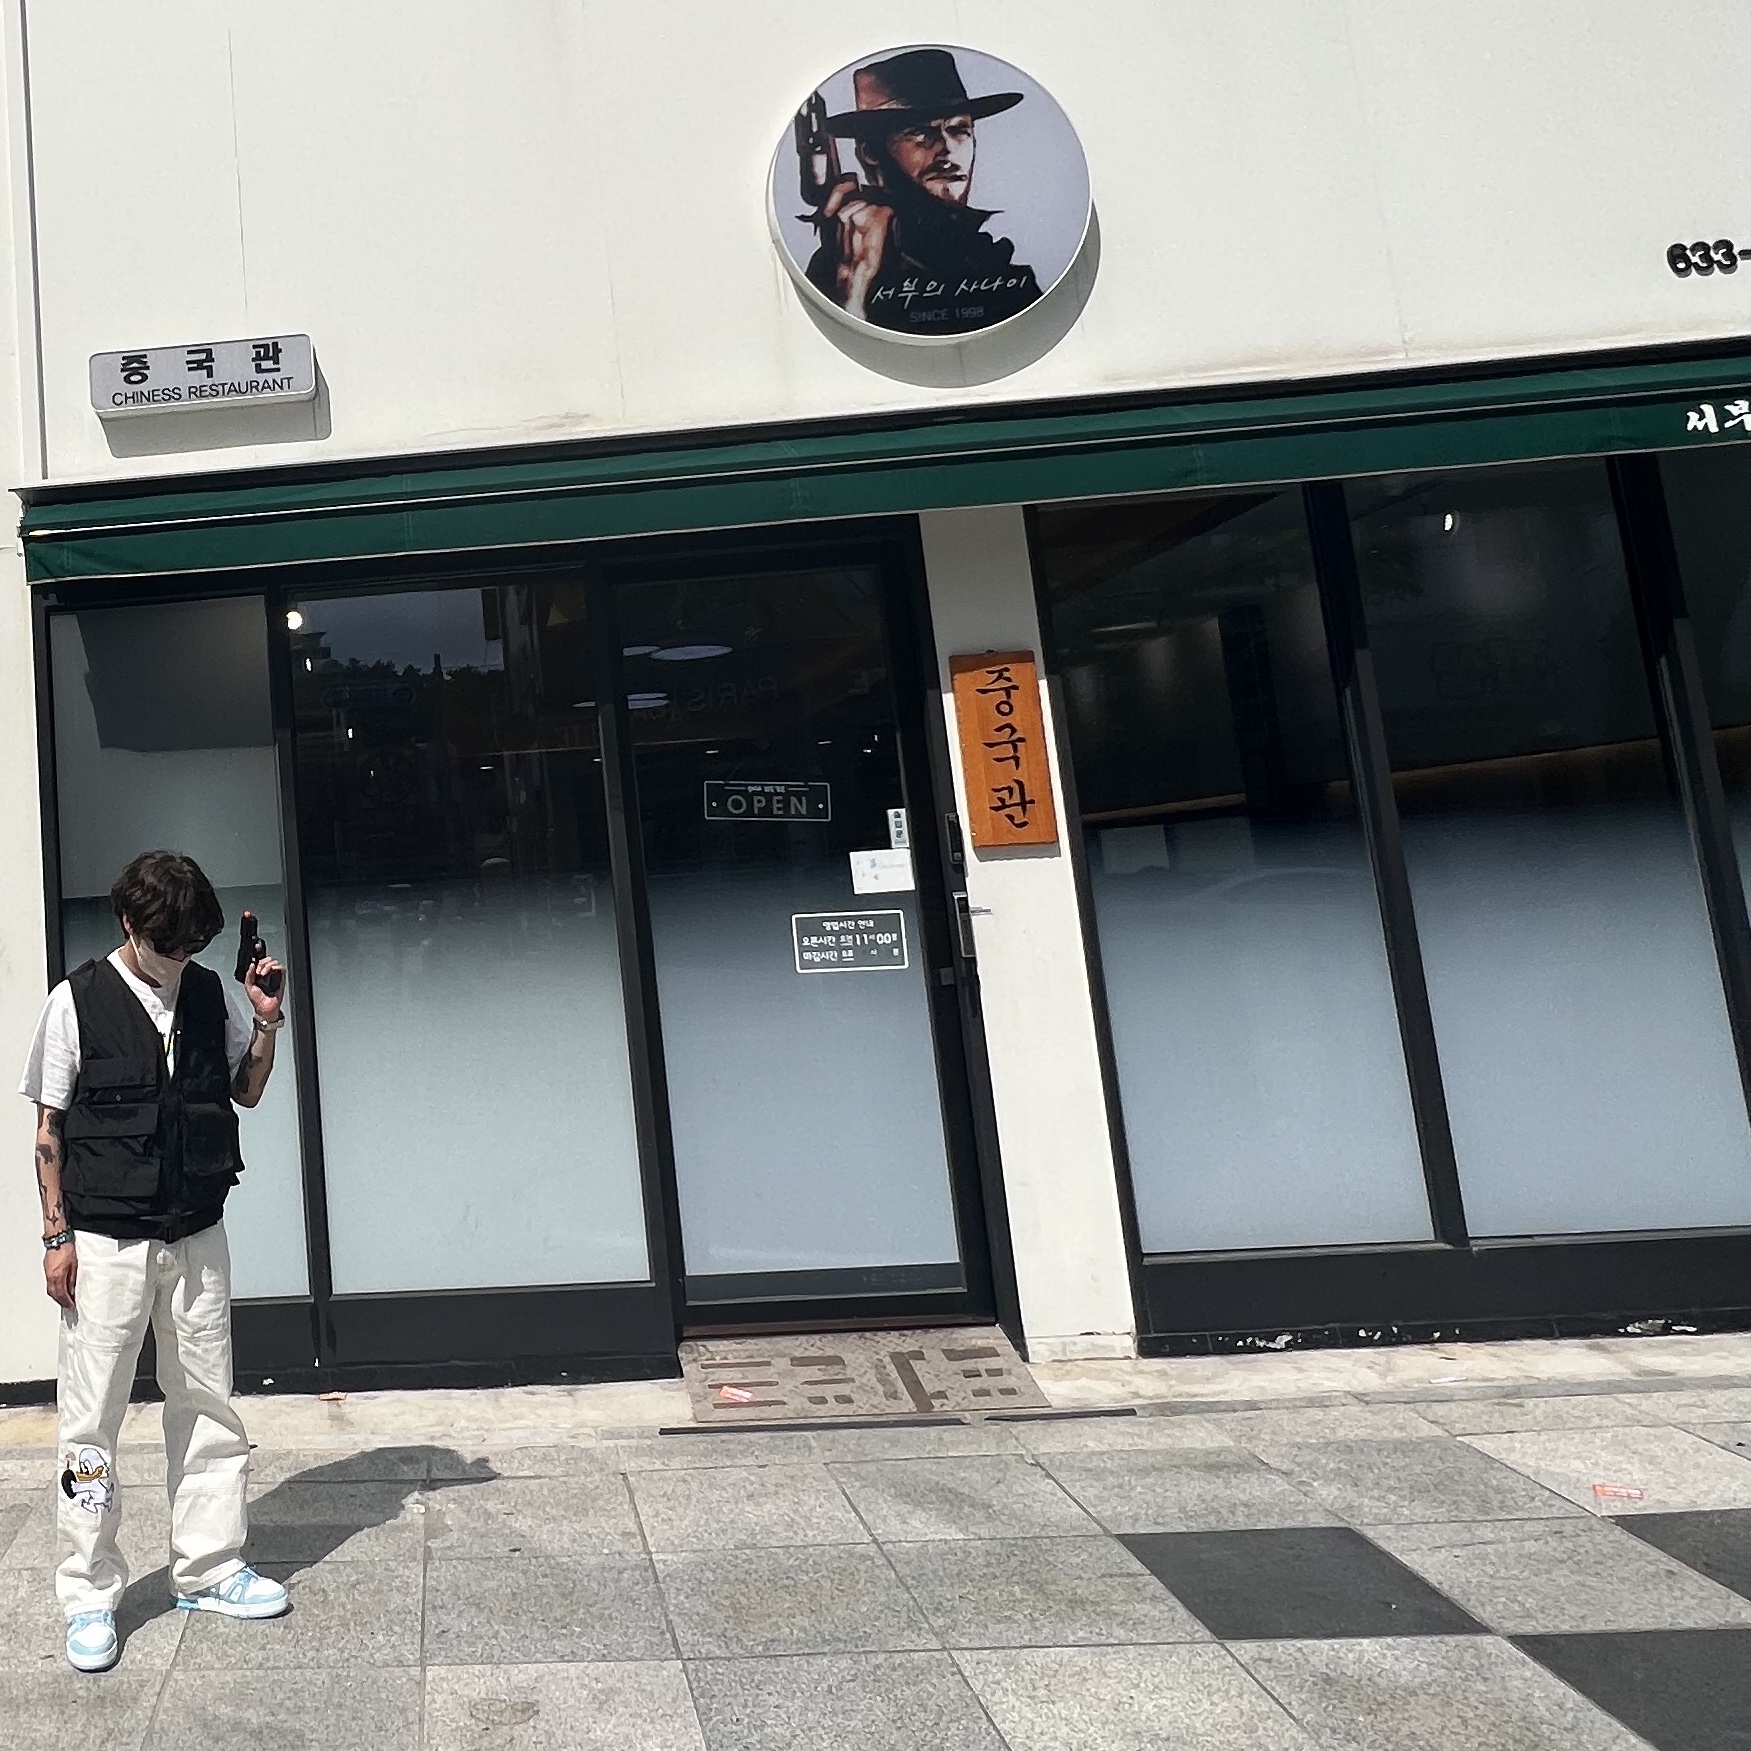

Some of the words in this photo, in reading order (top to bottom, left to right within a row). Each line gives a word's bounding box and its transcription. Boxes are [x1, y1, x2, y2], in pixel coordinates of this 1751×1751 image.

[871, 277, 946, 310] 서부의
[954, 275, 1028, 297] 사나이
[909, 307, 950, 323] SINCE
[955, 306, 985, 320] 1998
[111, 386, 182, 406] CHINESS
[187, 376, 294, 399] RESTAURANT
[726, 794, 808, 815] OPEN
